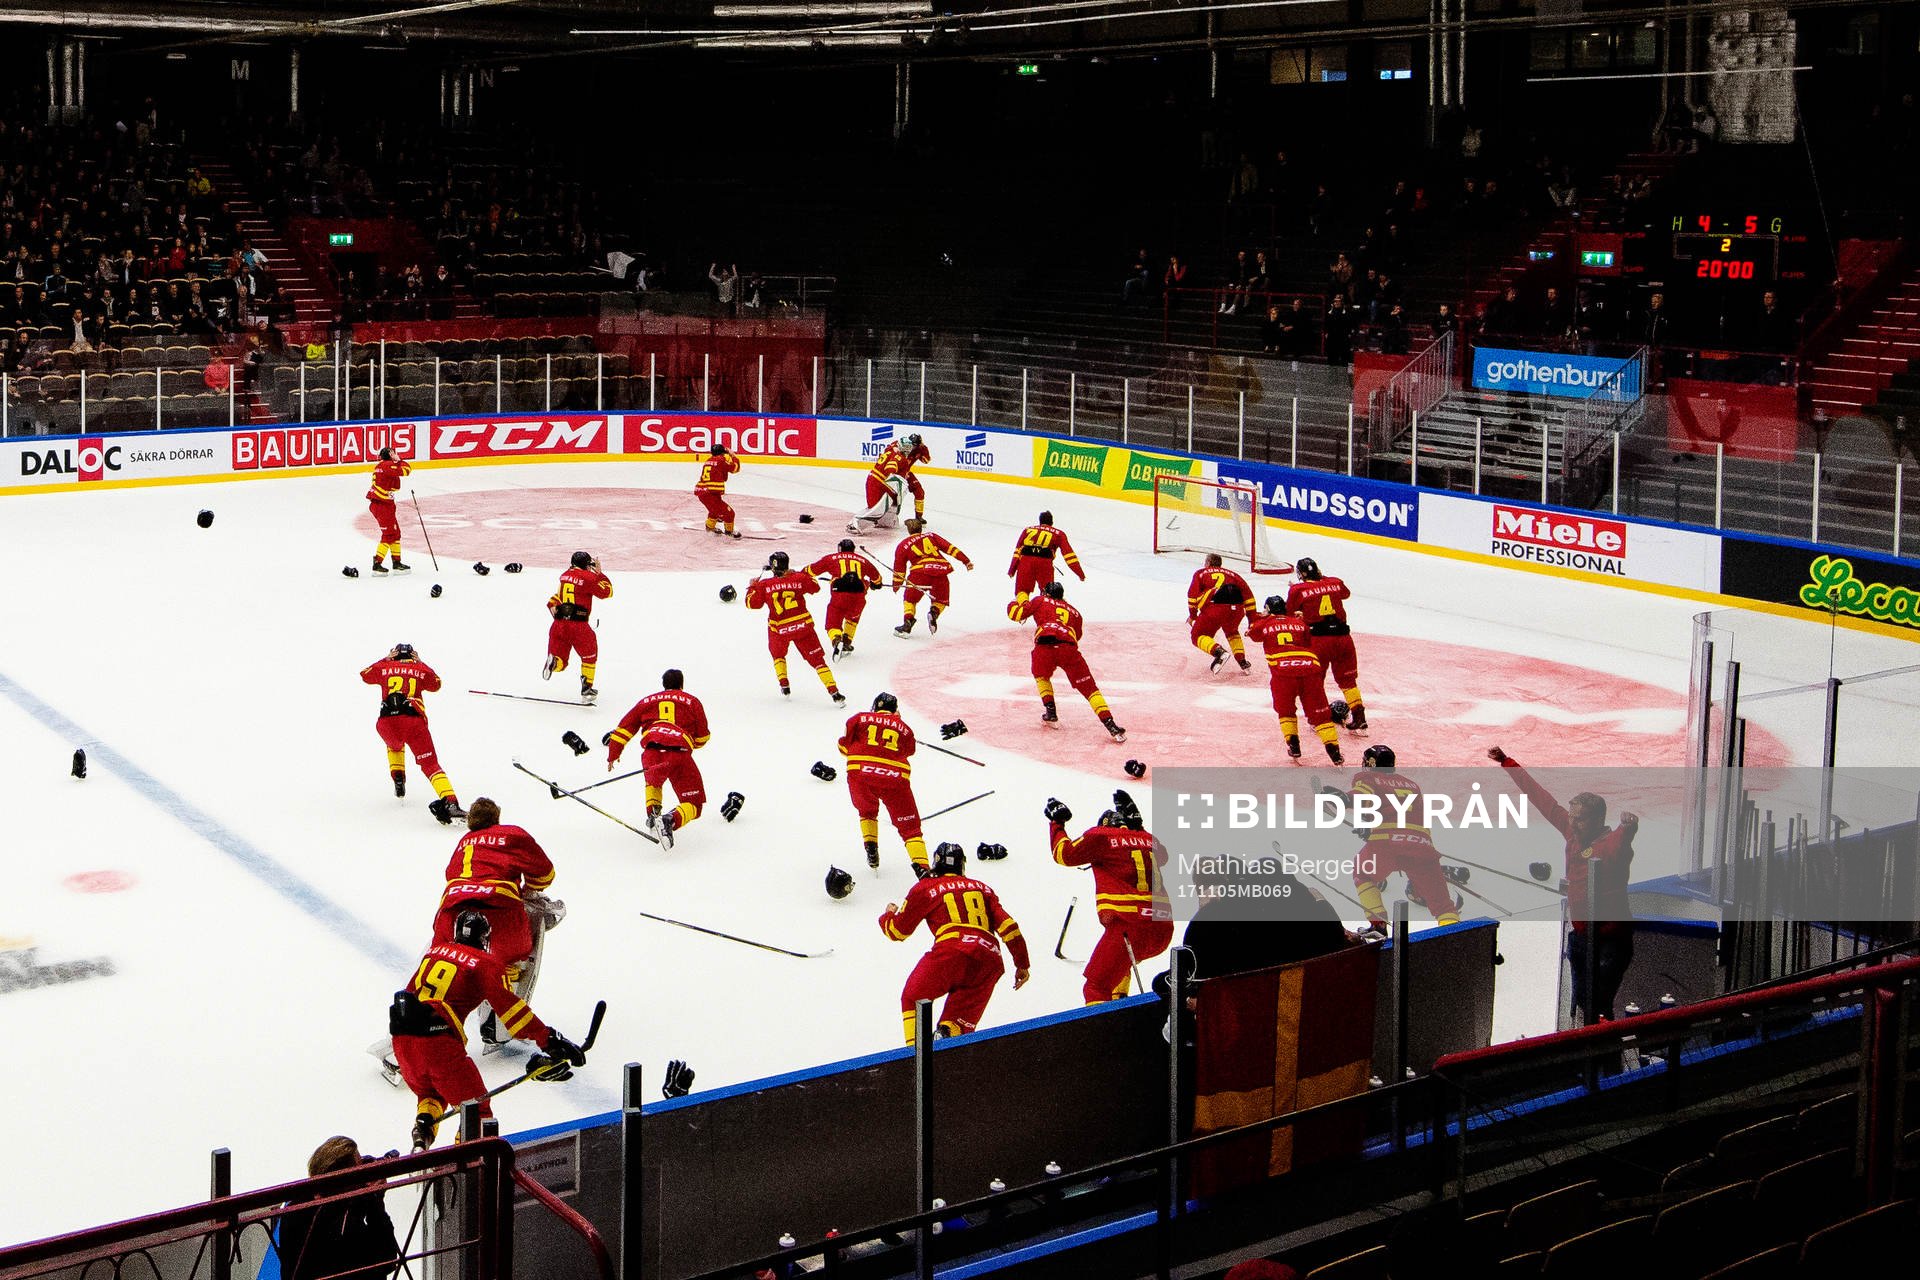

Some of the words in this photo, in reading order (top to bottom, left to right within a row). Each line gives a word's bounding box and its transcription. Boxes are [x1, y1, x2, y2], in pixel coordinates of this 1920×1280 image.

[232, 60, 249, 80] M
[480, 69, 494, 87] N
[1672, 216, 1682, 231] H
[1699, 215, 1711, 232] 4
[1746, 215, 1757, 233] 5
[1771, 217, 1782, 233] G
[1721, 238, 1731, 252] 2
[235, 427, 412, 464] BAUHAUS
[434, 420, 604, 454] CCM
[640, 418, 799, 455] Scandic
[21, 446, 121, 476] DALOC
[130, 452, 166, 463] SÄKRA
[169, 448, 214, 461] DÖRRAR
[956, 450, 994, 467] NOCCO
[1023, 528, 1053, 548] 20
[1496, 510, 1622, 551] Miele
[1491, 540, 1626, 576] PROFESSIONAL
[771, 590, 799, 615] 12
[1318, 594, 1336, 616] 4
[381, 667, 426, 679] BAUHAUS
[387, 675, 417, 699] 21
[658, 701, 675, 725] 9
[860, 715, 910, 736] BAUHAUS
[861, 765, 900, 777] CCM
[460, 844, 474, 878] 1
[449, 884, 494, 895] CCM
[929, 882, 993, 898] BAUHAUS
[943, 890, 989, 930] 18
[415, 957, 458, 1003] 19
